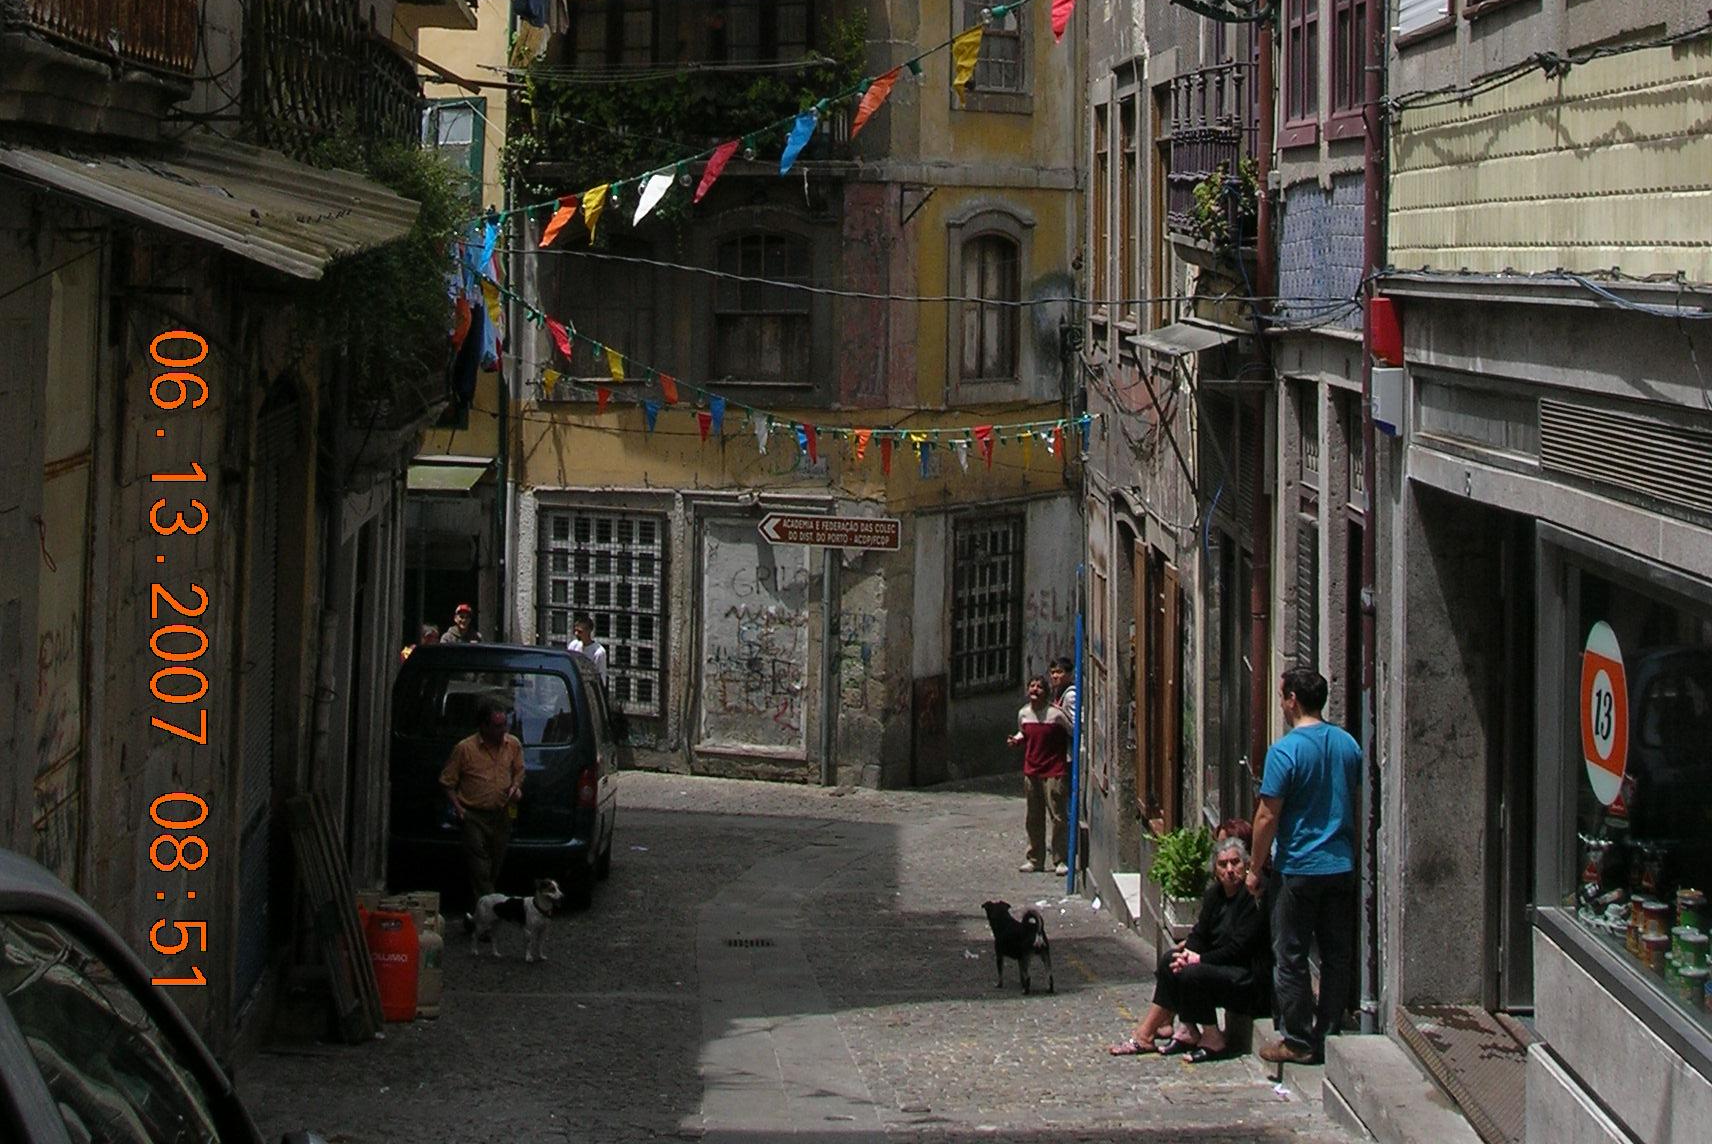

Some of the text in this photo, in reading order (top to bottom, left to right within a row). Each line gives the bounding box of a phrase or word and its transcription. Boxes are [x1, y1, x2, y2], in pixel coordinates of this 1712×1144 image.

[782, 518, 814, 530] ACADEMIA
[815, 520, 820, 530] E
[821, 520, 859, 533] FEDERAÇÃO
[860, 522, 874, 533] DAS
[788, 530, 798, 541] DO
[800, 531, 814, 542] DIST.
[816, 532, 826, 542] DO
[827, 533, 848, 544] PORTO
[1595, 689, 1612, 740] 13
